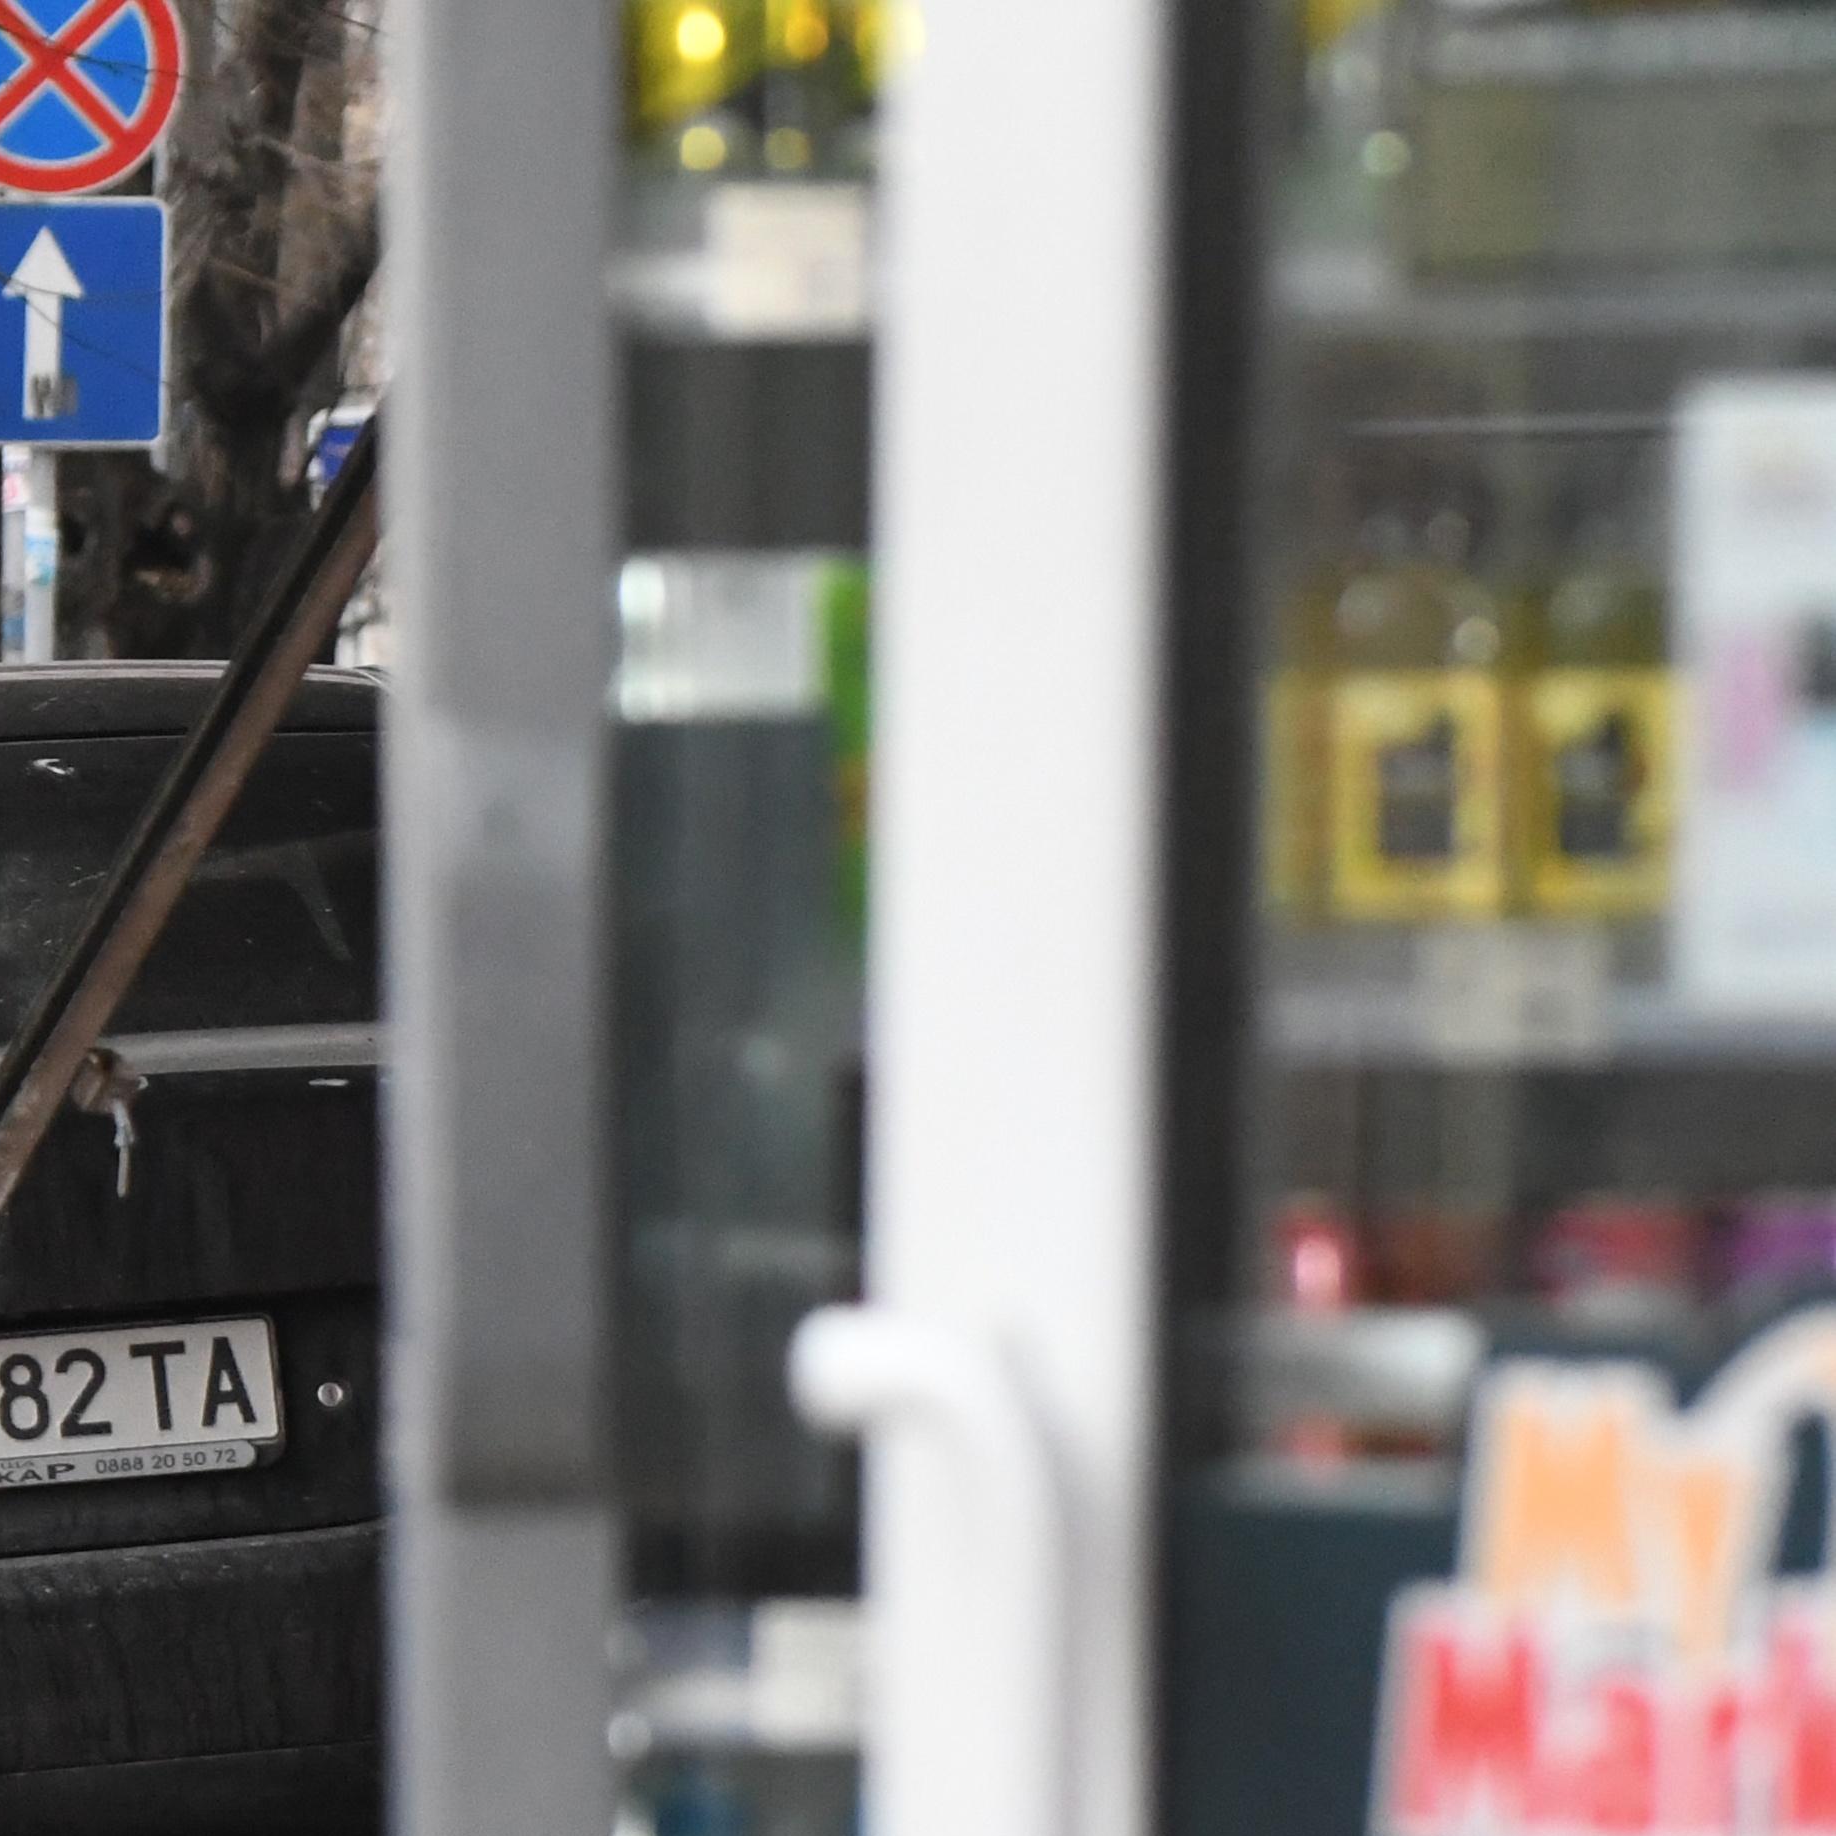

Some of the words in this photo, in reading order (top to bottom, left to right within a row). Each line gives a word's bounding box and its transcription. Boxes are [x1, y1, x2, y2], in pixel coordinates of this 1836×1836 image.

[95, 1457, 145, 1475] 0888
[151, 1454, 177, 1470] 20
[182, 1451, 207, 1467] 50
[215, 1448, 238, 1464] 72
